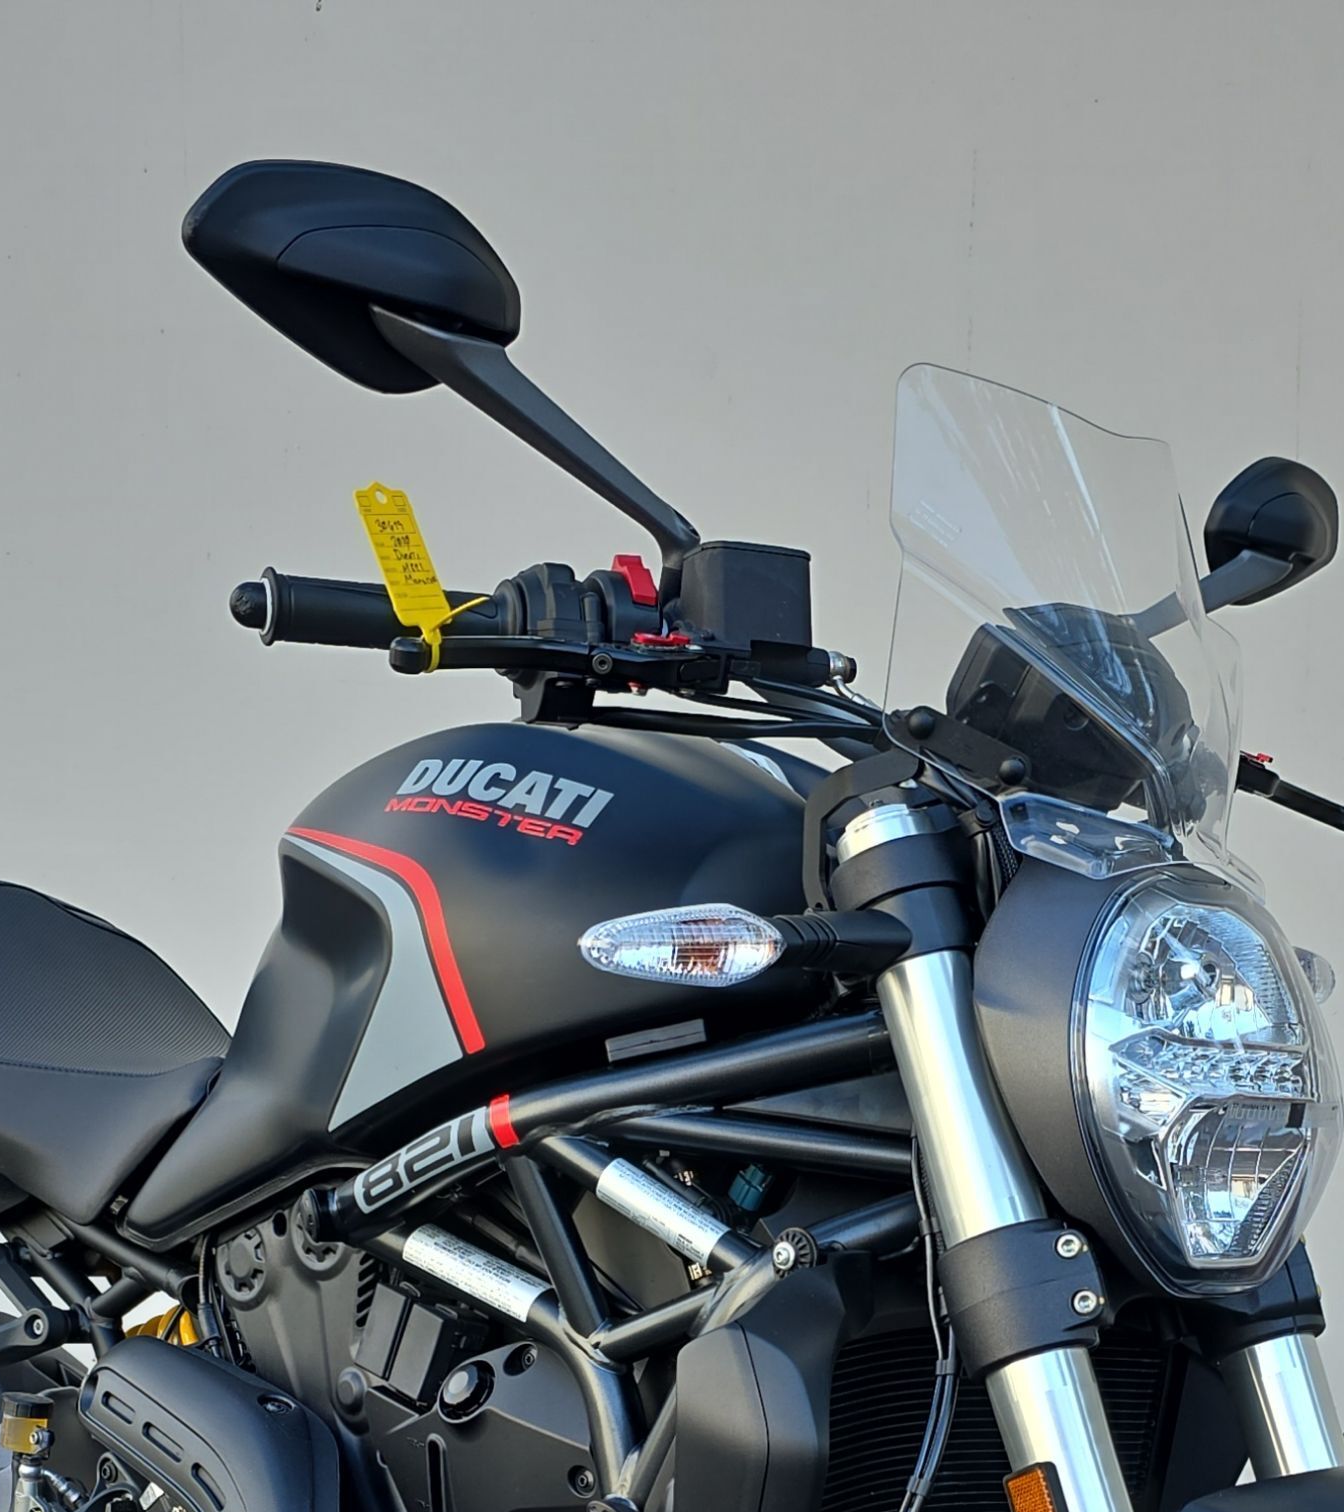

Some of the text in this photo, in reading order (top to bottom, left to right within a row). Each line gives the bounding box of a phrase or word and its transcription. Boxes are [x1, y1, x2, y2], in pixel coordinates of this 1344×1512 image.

[384, 796, 584, 846] MONSTER
[396, 759, 615, 828] DUCATI
[362, 1114, 477, 1207] 821
